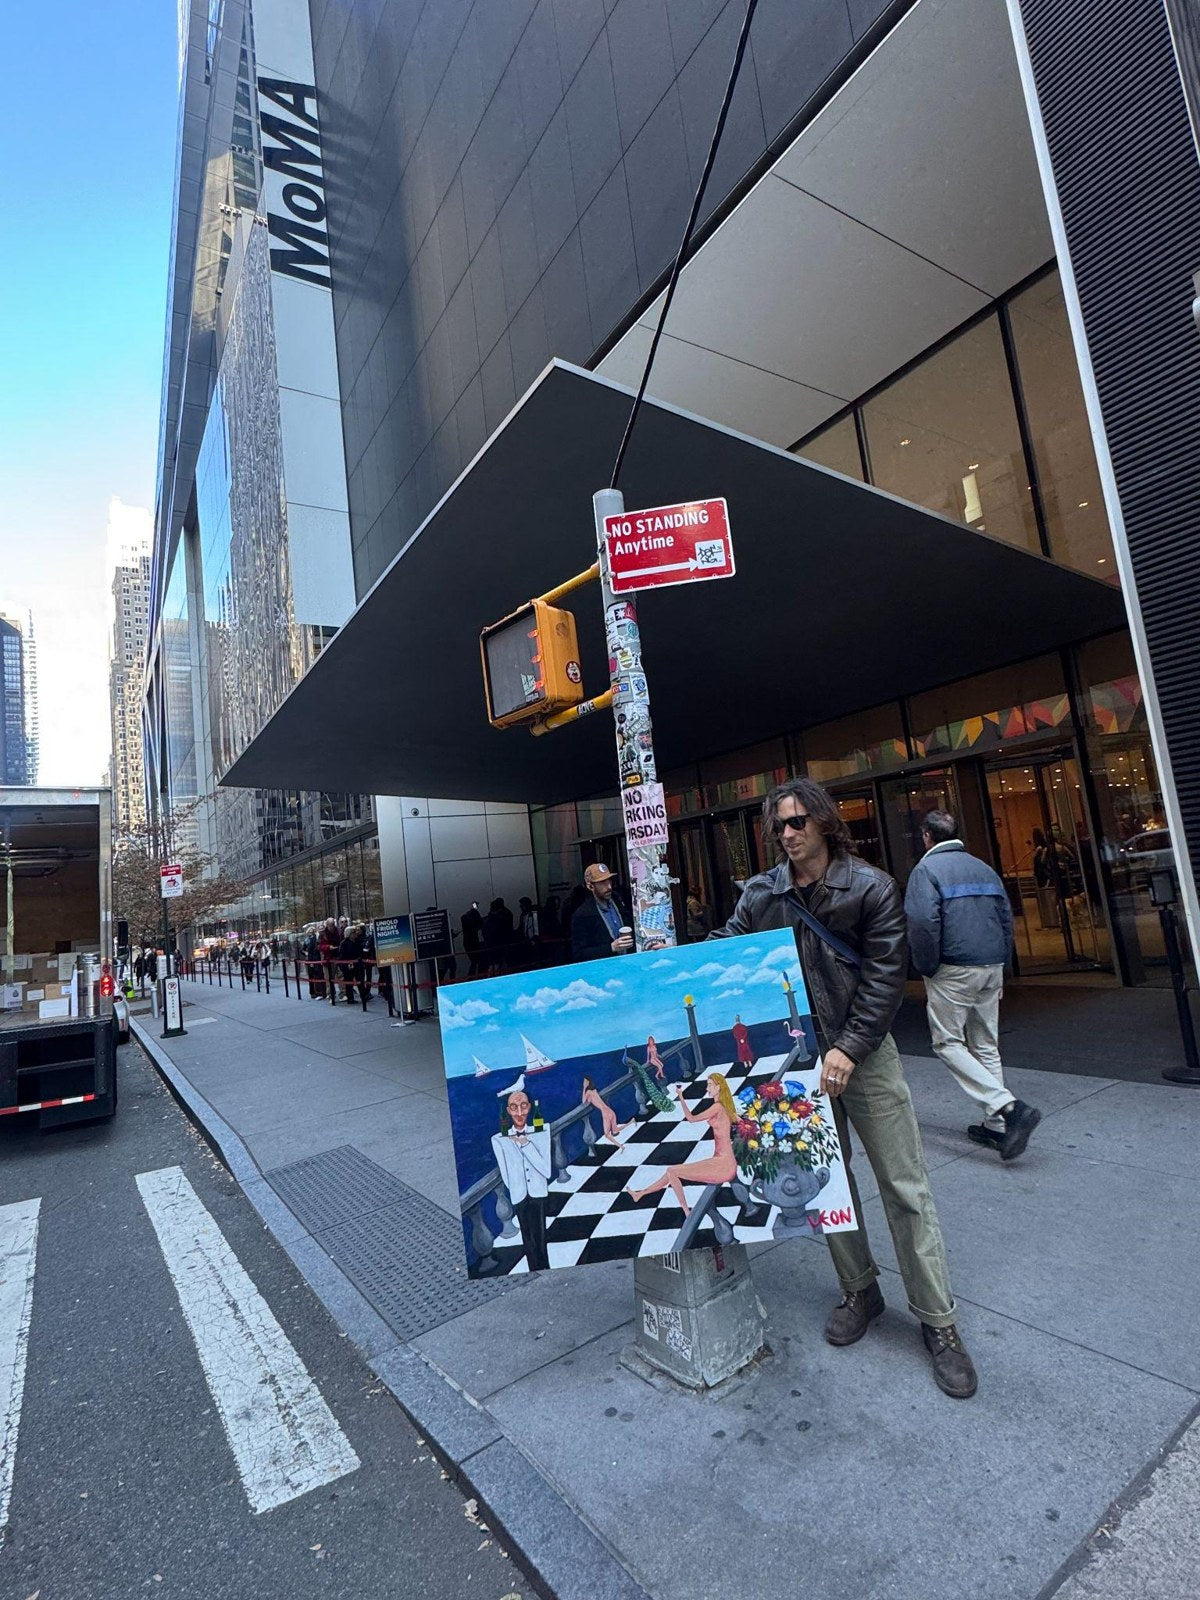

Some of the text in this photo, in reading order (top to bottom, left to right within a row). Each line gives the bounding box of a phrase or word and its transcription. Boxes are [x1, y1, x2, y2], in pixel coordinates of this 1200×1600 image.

[258, 76, 332, 290] MoMA
[611, 510, 709, 538] NO STANDING
[614, 535, 674, 556] Anytime
[624, 790, 642, 807] NO
[626, 804, 665, 824] RKING
[376, 924, 397, 932] FRIDAY
[807, 1206, 852, 1229] LEON
